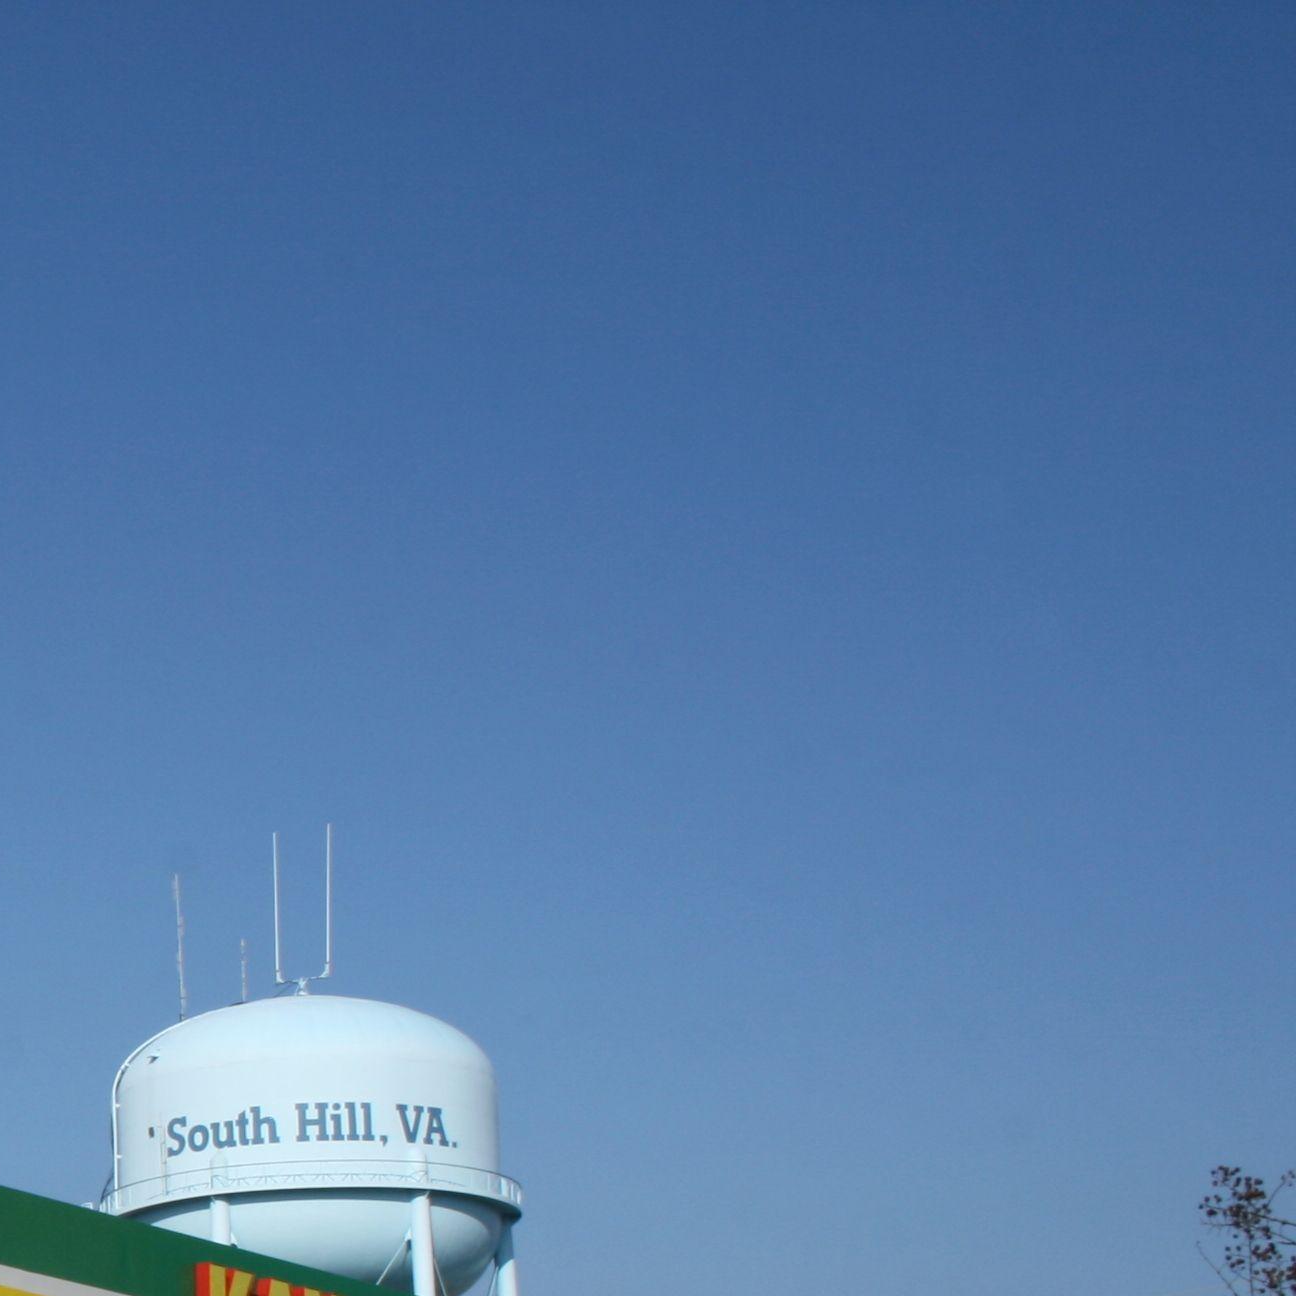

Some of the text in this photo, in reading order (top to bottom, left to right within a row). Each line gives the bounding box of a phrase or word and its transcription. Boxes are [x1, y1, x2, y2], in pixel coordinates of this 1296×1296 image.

[166, 1101, 458, 1157] South Hill, VA.
